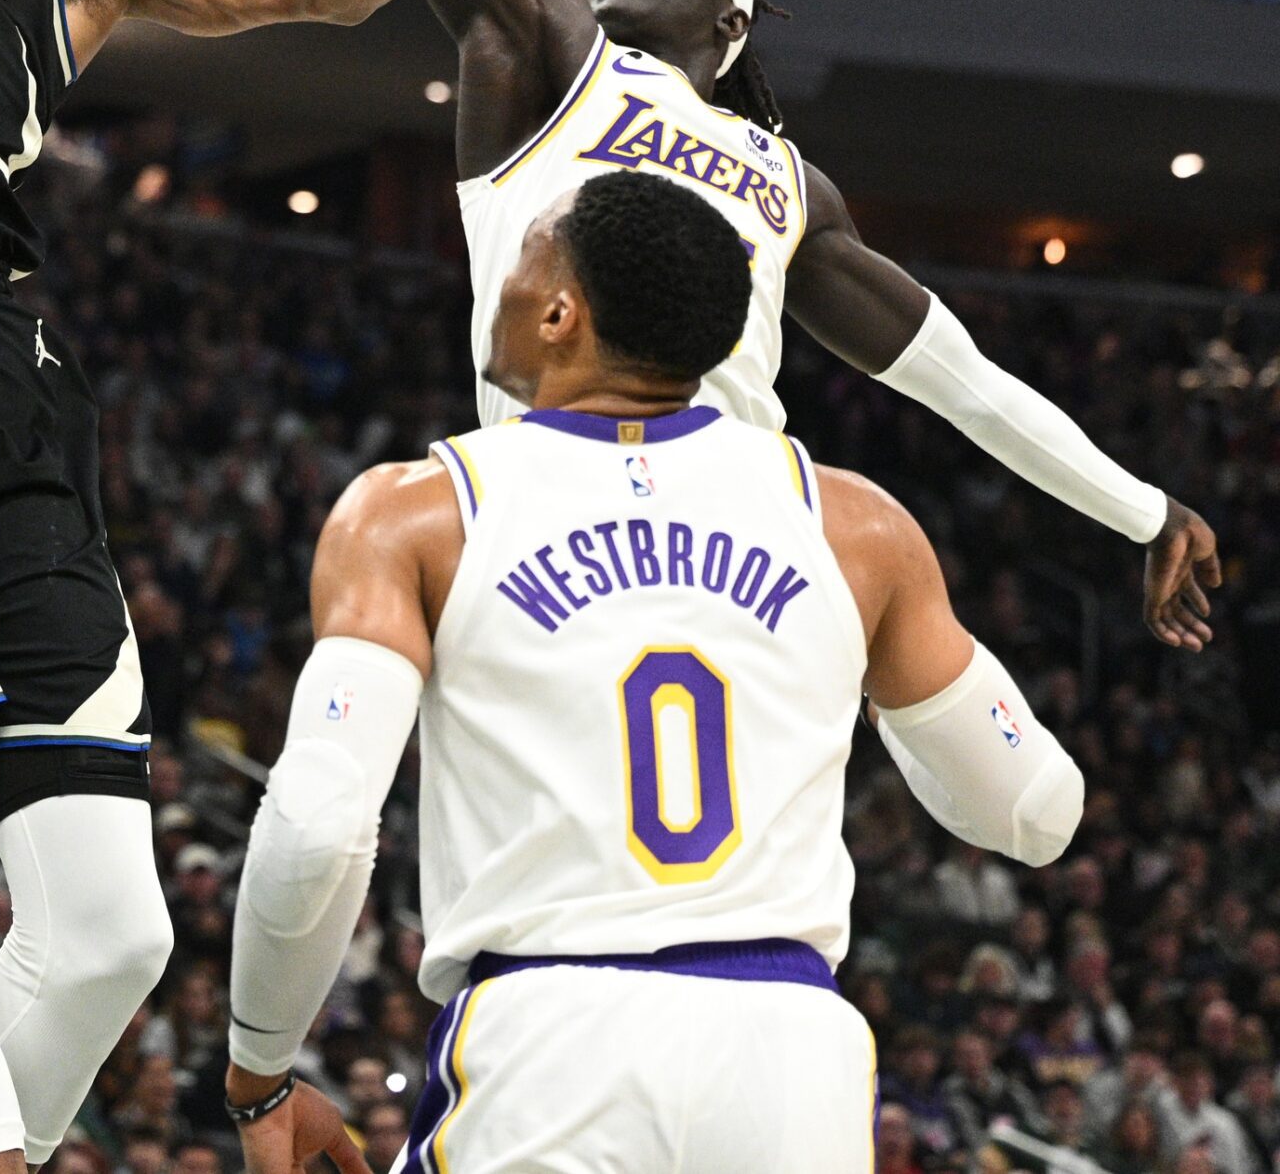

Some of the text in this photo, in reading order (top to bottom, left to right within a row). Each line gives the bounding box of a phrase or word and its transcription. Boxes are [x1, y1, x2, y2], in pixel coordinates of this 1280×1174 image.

[576, 92, 789, 236] LAKERS
[496, 518, 810, 634] WESTBROOK
[616, 644, 742, 886] 0
